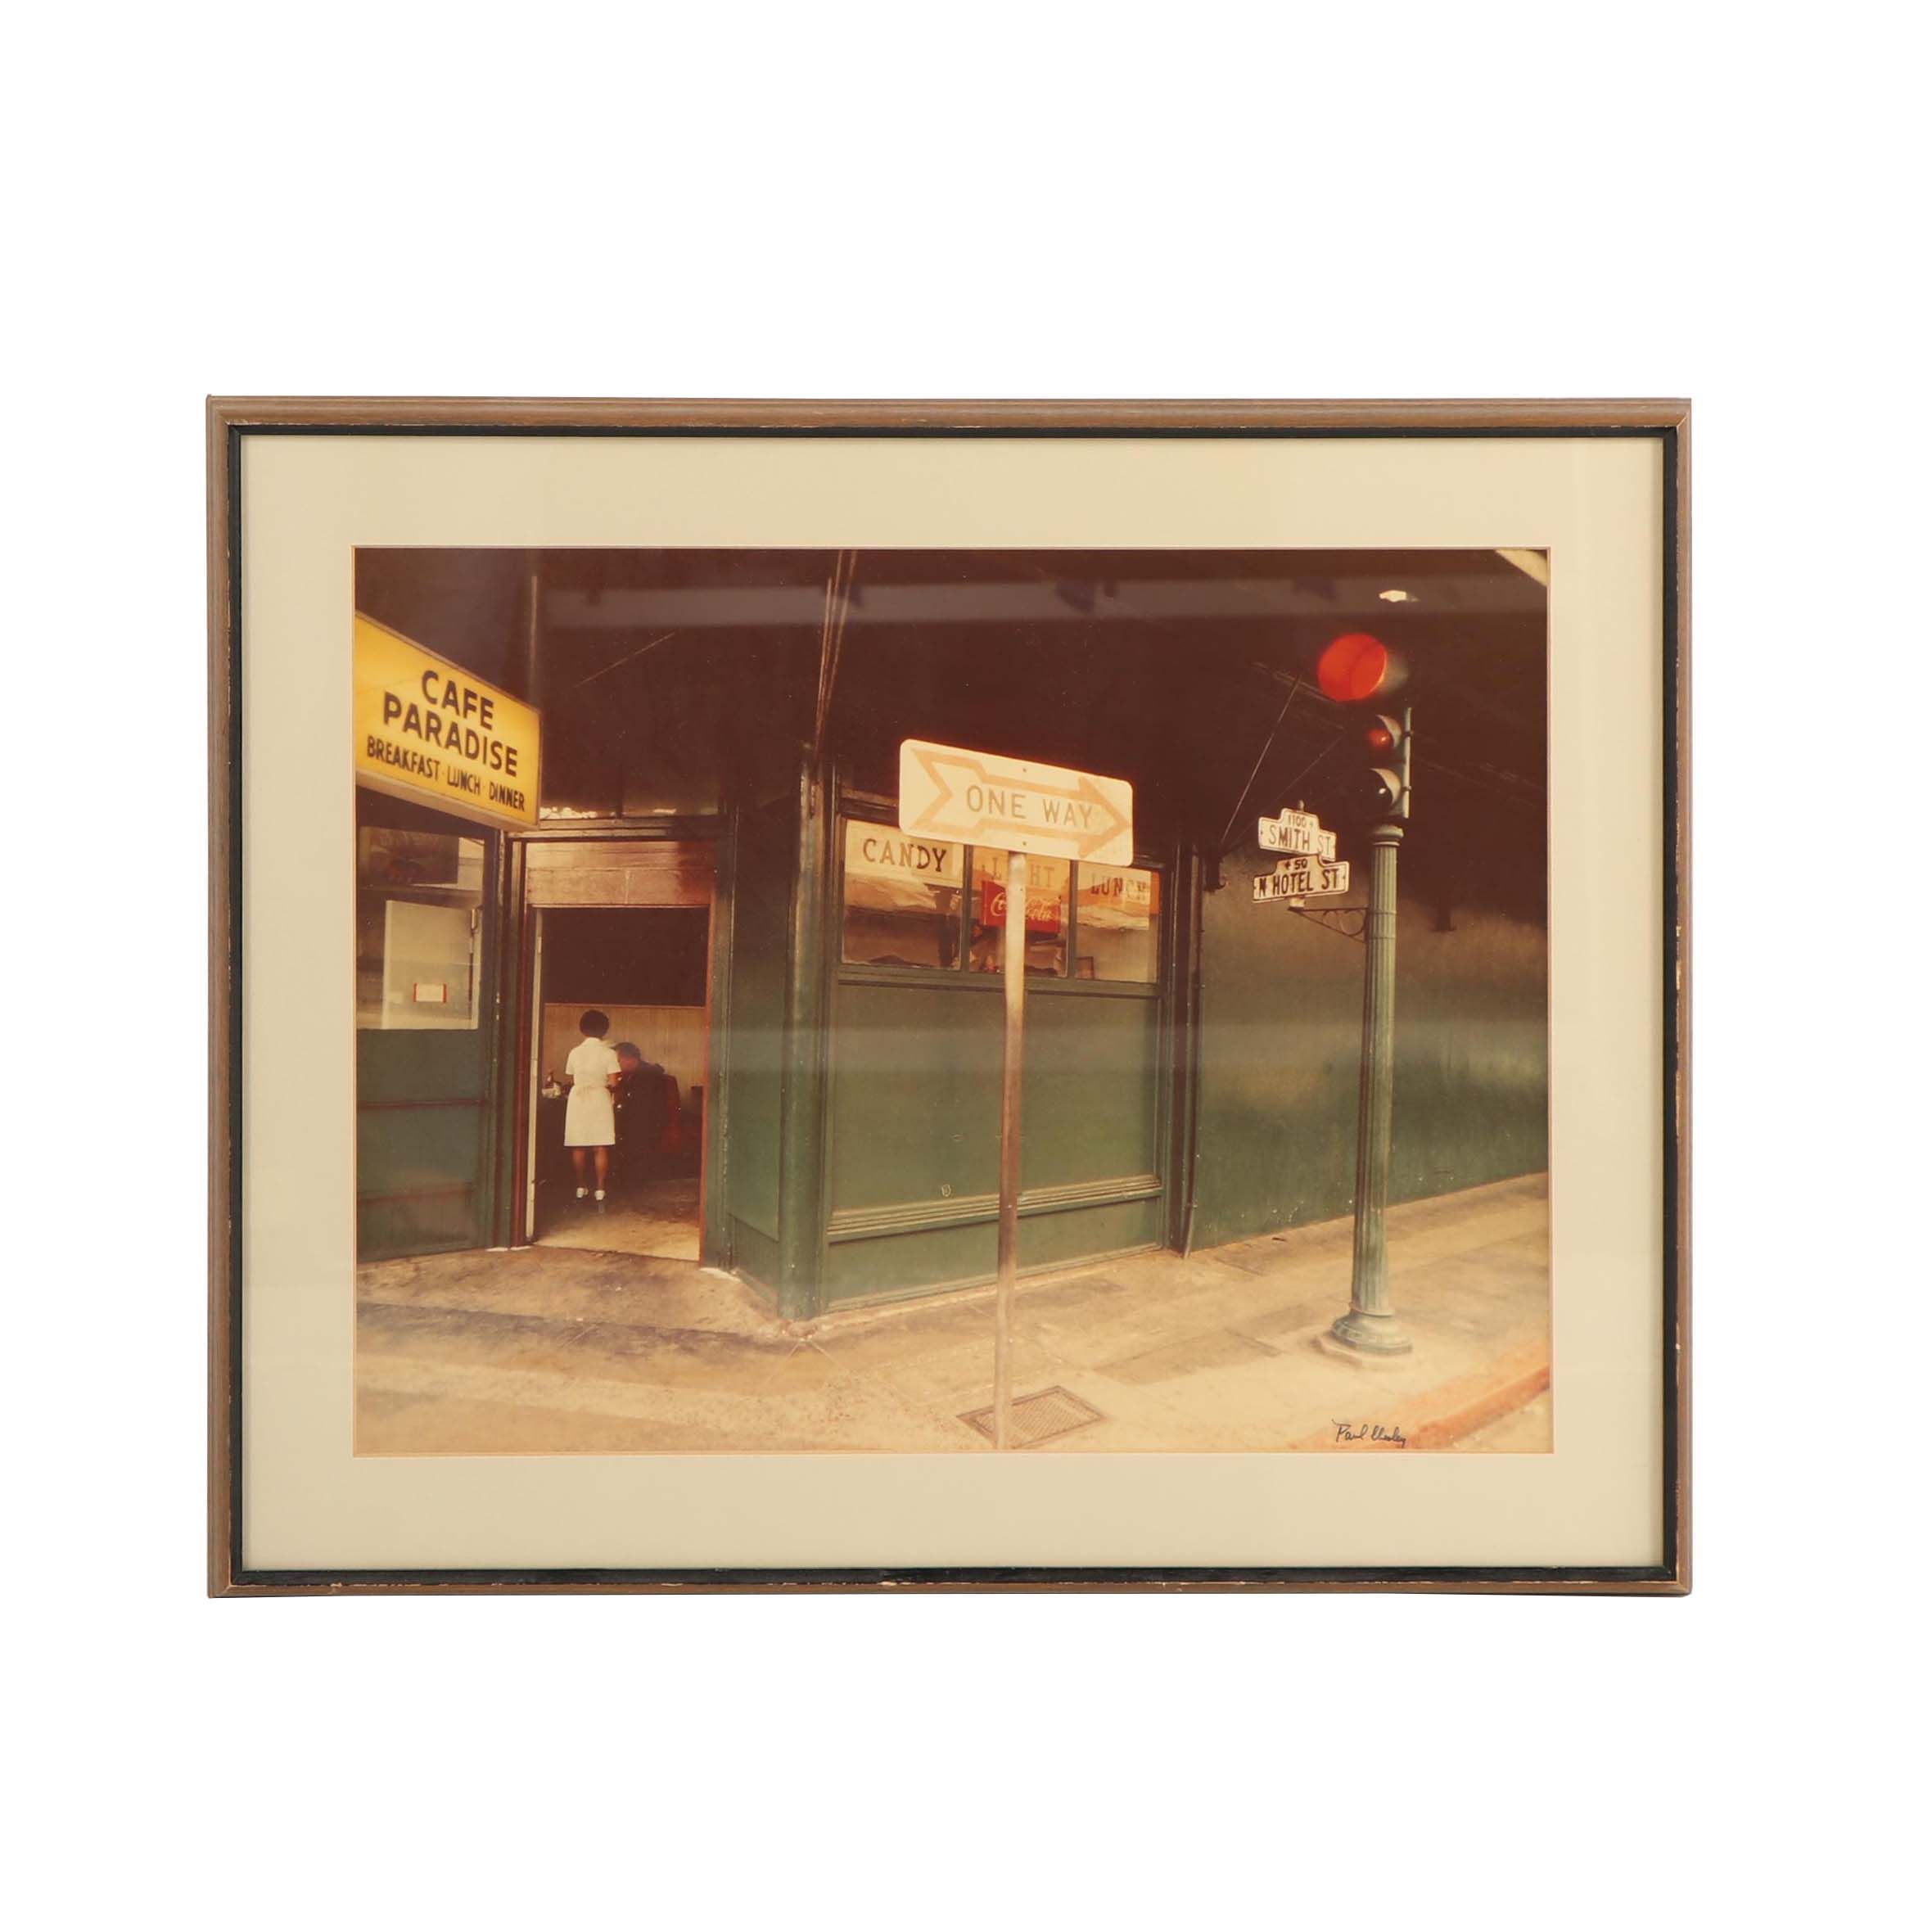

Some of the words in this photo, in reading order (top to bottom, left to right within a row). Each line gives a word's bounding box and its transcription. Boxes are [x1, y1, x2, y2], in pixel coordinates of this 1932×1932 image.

[422, 670, 494, 730] CAFE
[383, 692, 517, 777] PARADISE
[367, 734, 440, 781] BREAKFAST
[447, 765, 481, 796] LUNCH
[489, 781, 525, 811] DINNER
[966, 785, 1027, 819] ONE
[1043, 798, 1093, 828] WAY
[863, 838, 947, 873] CANDY
[1269, 824, 1310, 851] SMITH
[1317, 835, 1331, 855] ST
[991, 857, 1055, 888] LHT
[1294, 859, 1307, 869] 50
[1259, 877, 1267, 897] N
[1272, 871, 1314, 896] HOTEL
[1321, 869, 1339, 890] ST
[1331, 1418, 1369, 1442] Paul
